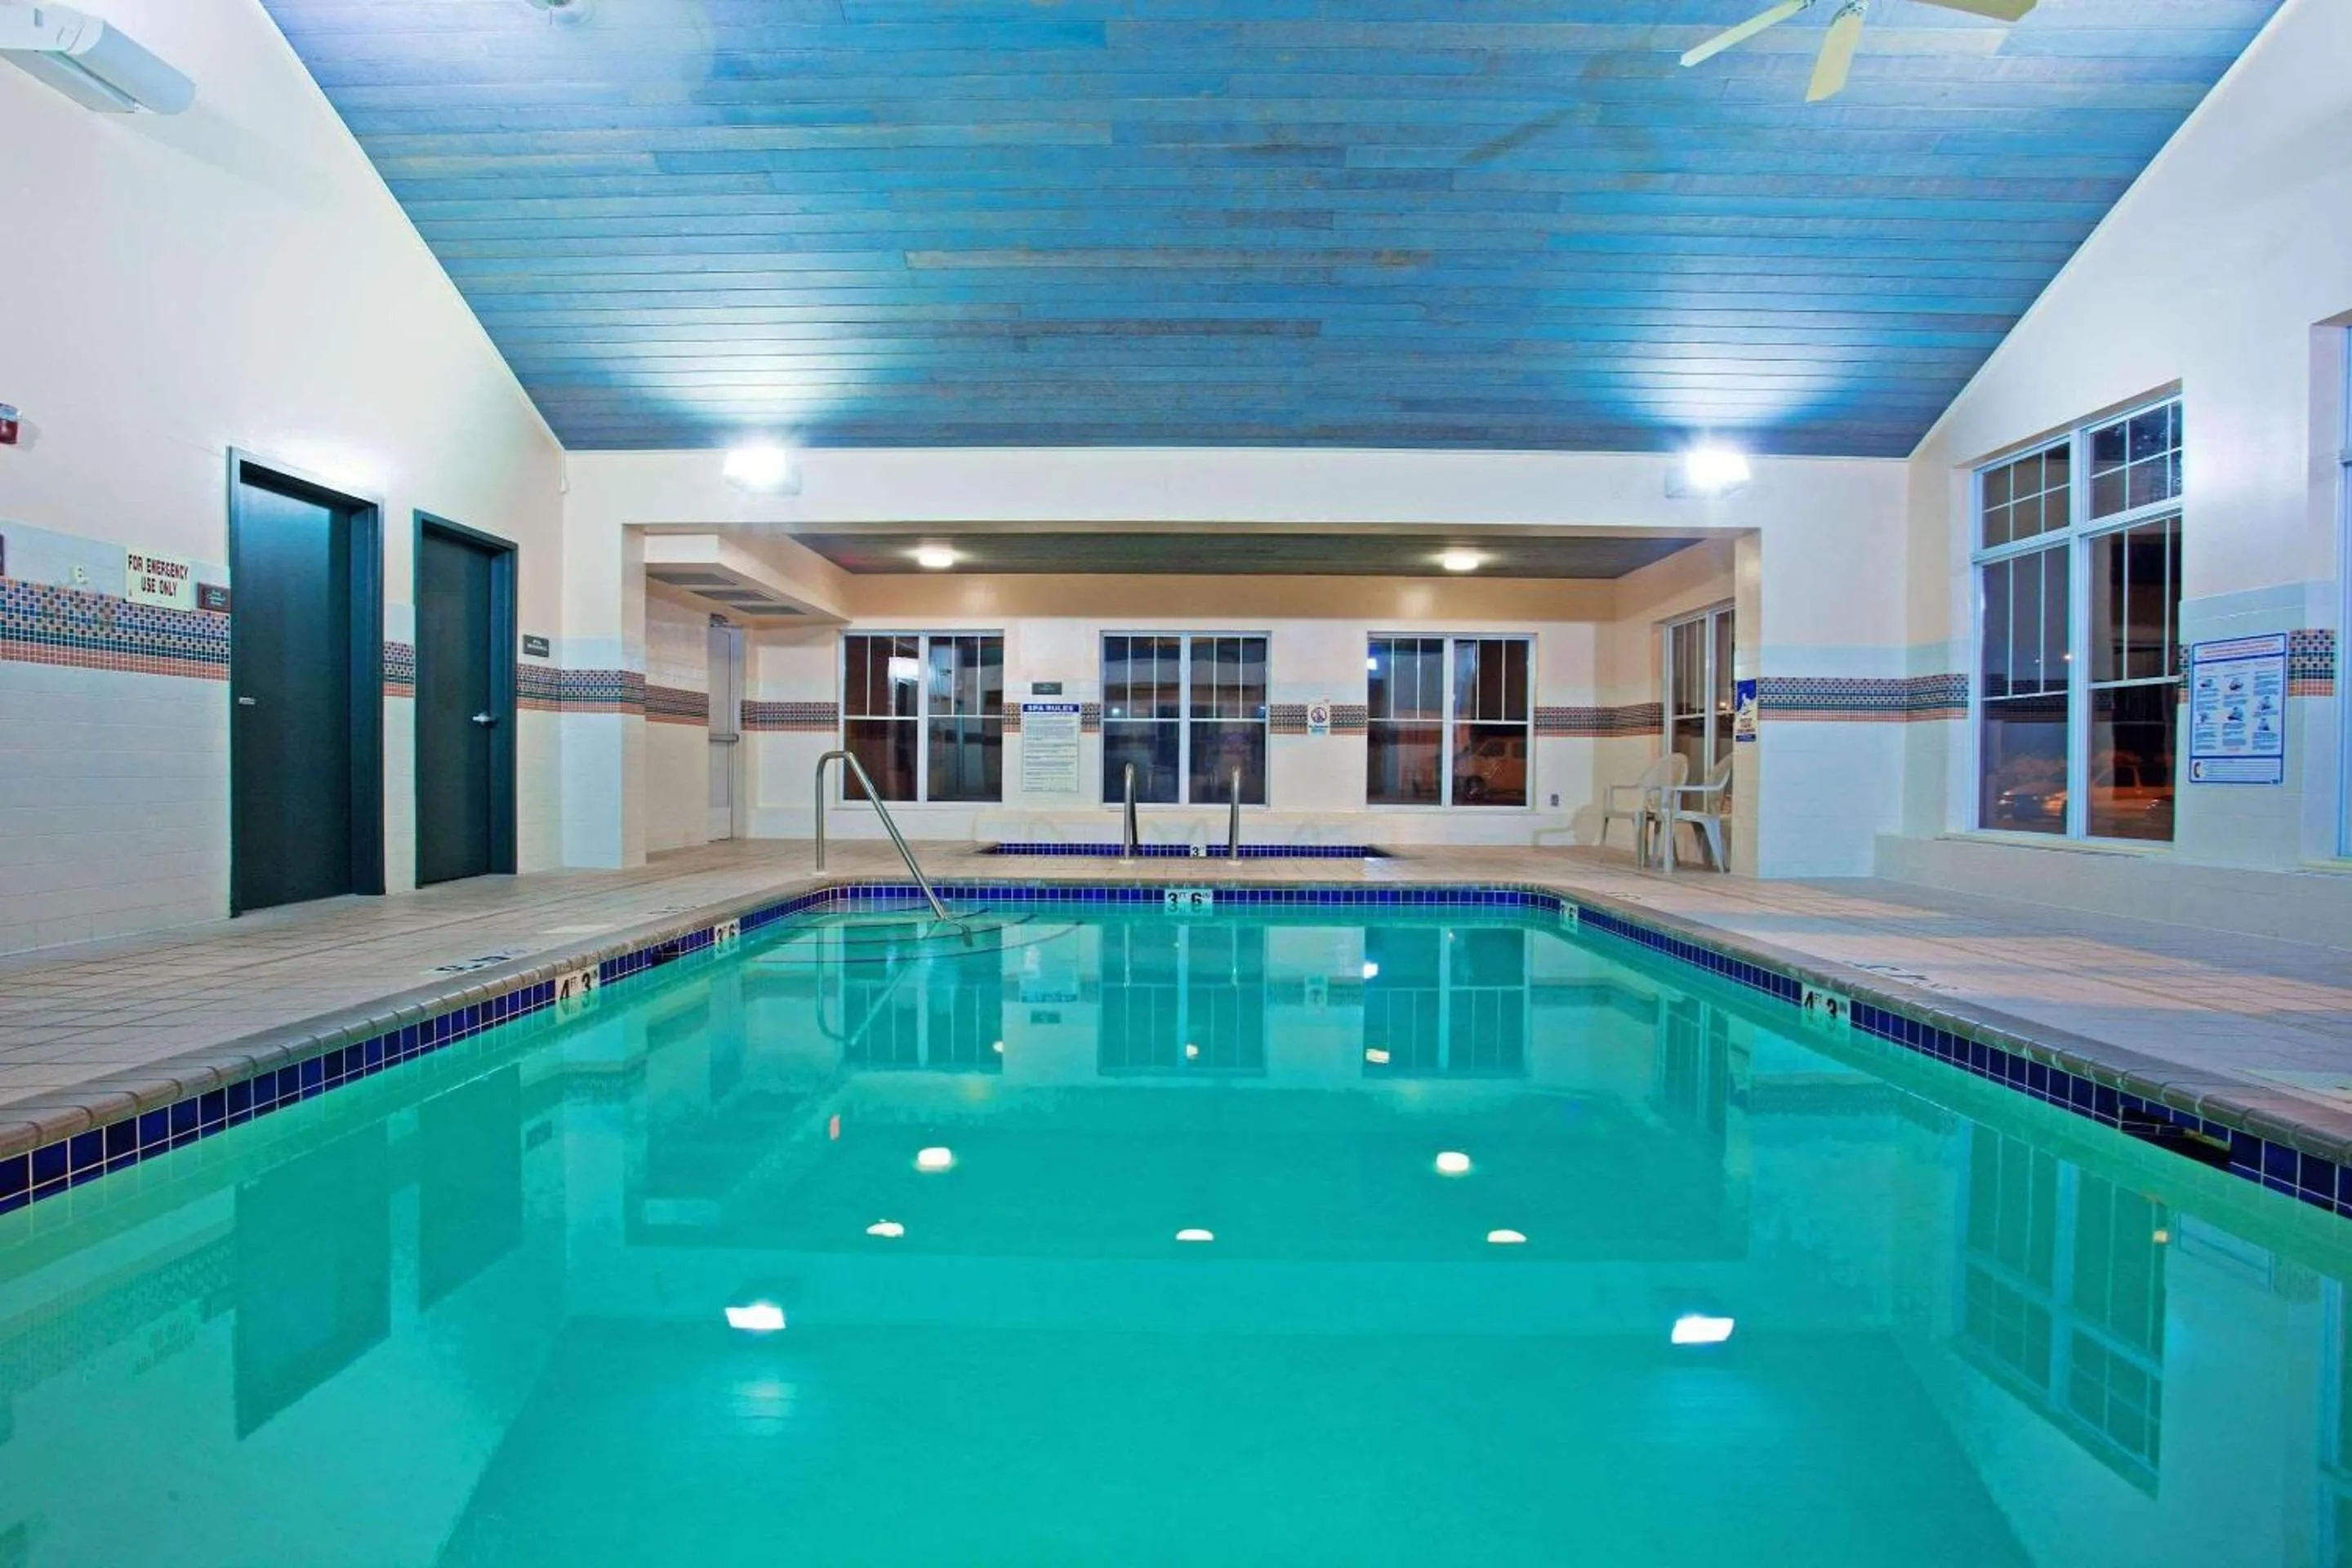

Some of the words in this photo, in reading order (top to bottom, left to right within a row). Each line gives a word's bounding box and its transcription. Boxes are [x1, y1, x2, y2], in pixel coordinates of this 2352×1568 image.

[128, 555, 143, 572] FOR
[147, 558, 189, 580] EMERGENCY
[141, 577, 155, 593] USE
[159, 580, 177, 598] ONLY
[1168, 892, 1178, 905] 3
[1191, 892, 1202, 905] 6
[581, 973, 591, 993] 3
